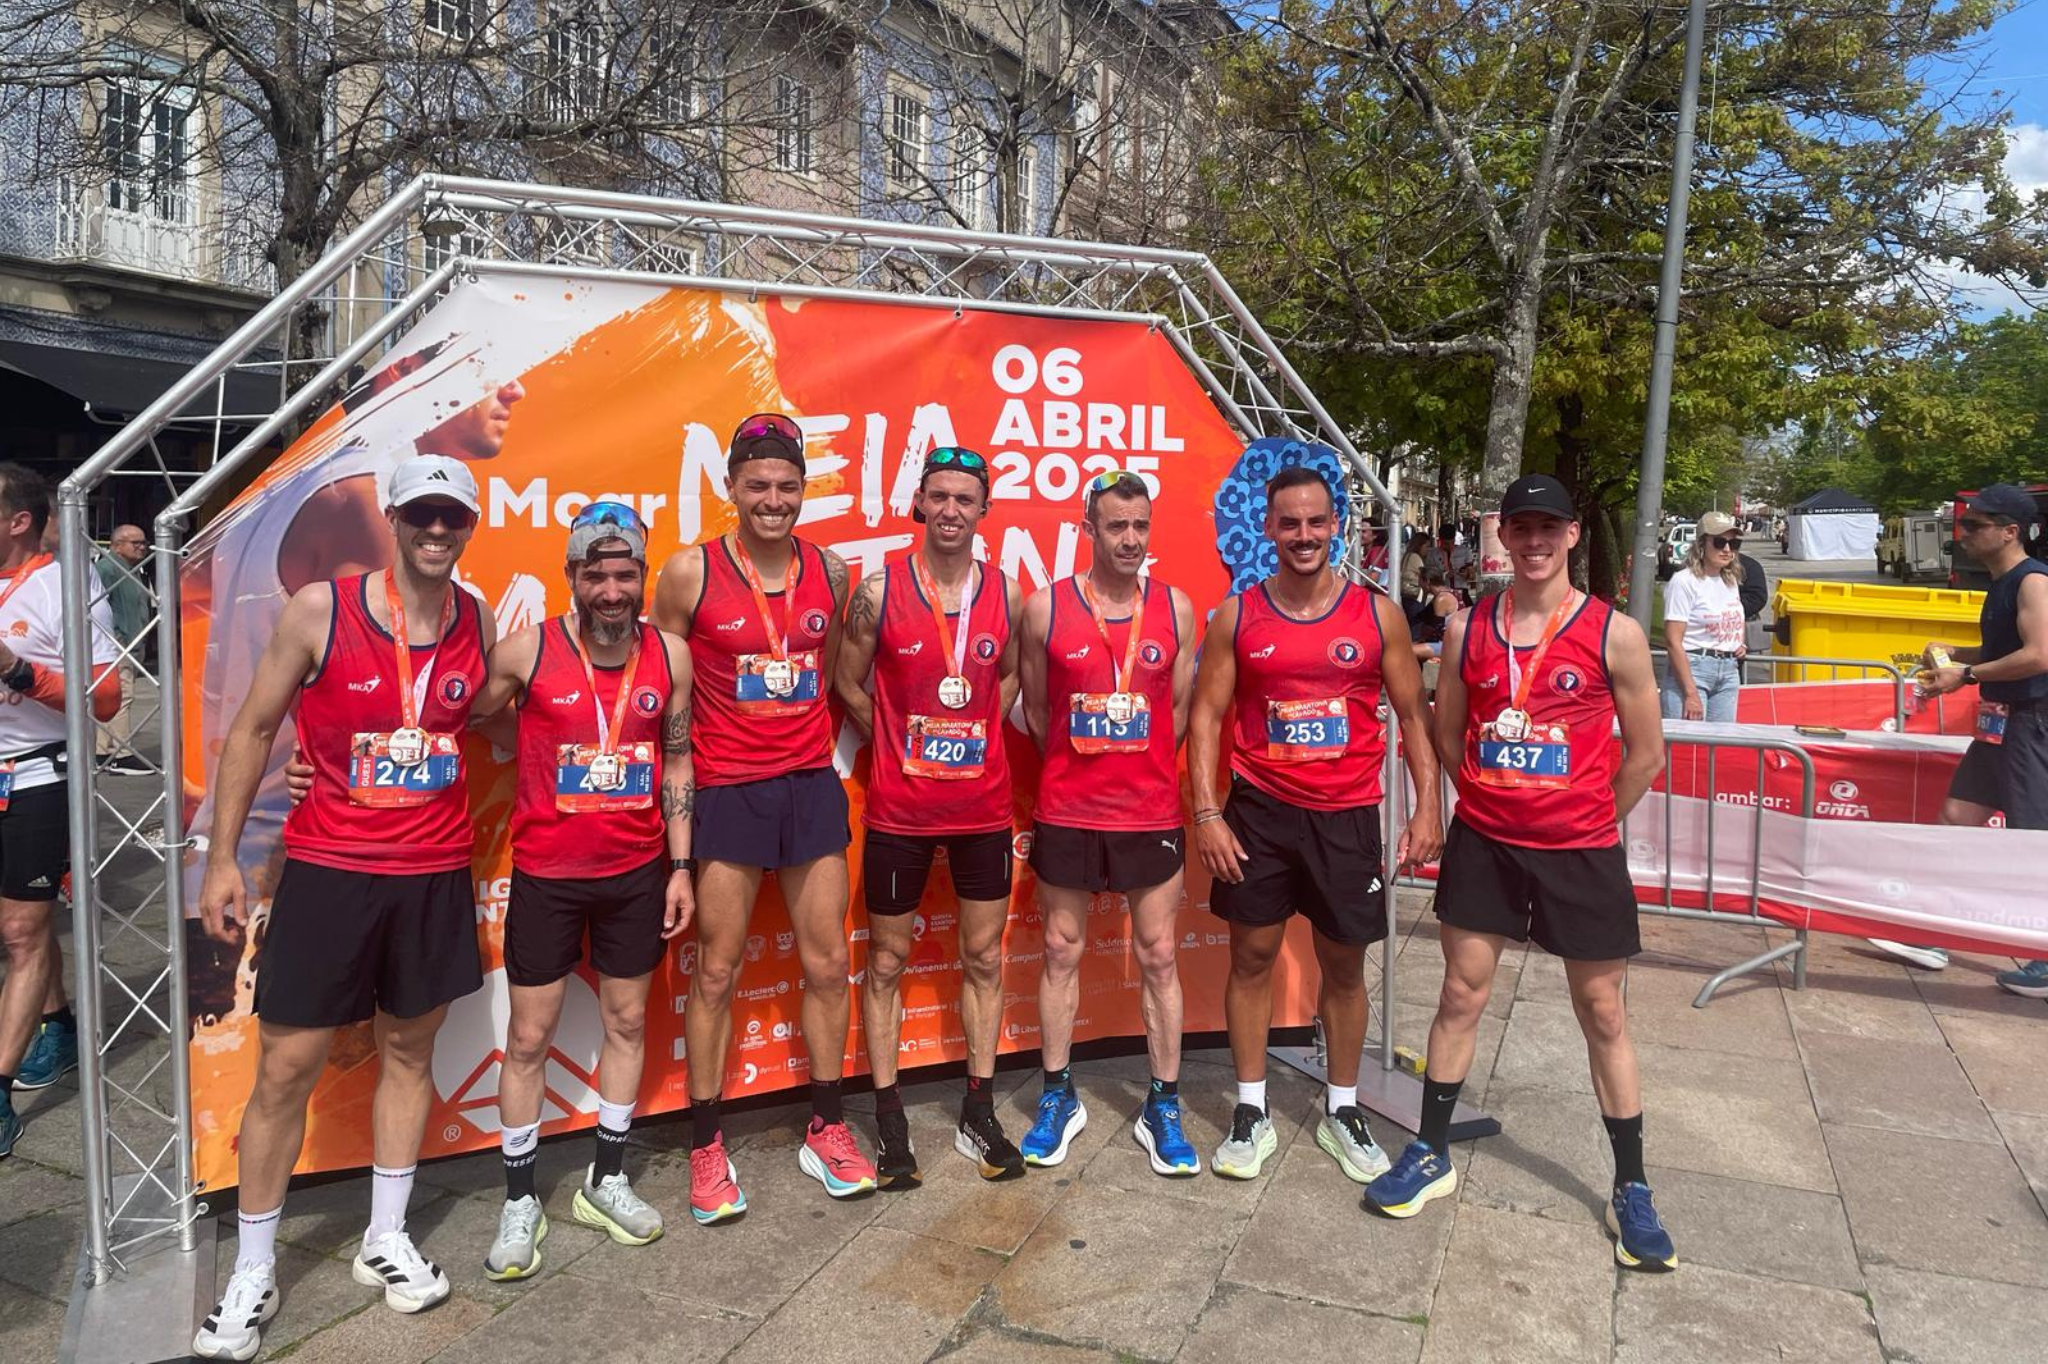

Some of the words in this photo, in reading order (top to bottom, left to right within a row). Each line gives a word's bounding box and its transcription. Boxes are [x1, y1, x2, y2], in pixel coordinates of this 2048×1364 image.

[991, 344, 1083, 397] 06
[990, 398, 1185, 452] ABRIL
[990, 451, 1161, 501] 2025
[1284, 722, 1326, 744] 253
[924, 739, 966, 762] 420
[1496, 746, 1543, 769] 437
[361, 758, 371, 787] GUEST
[375, 760, 431, 785] 274
[1715, 790, 1791, 810] ambar:
[1815, 801, 1870, 818] ONDA
[737, 985, 777, 998] E.Leclerc
